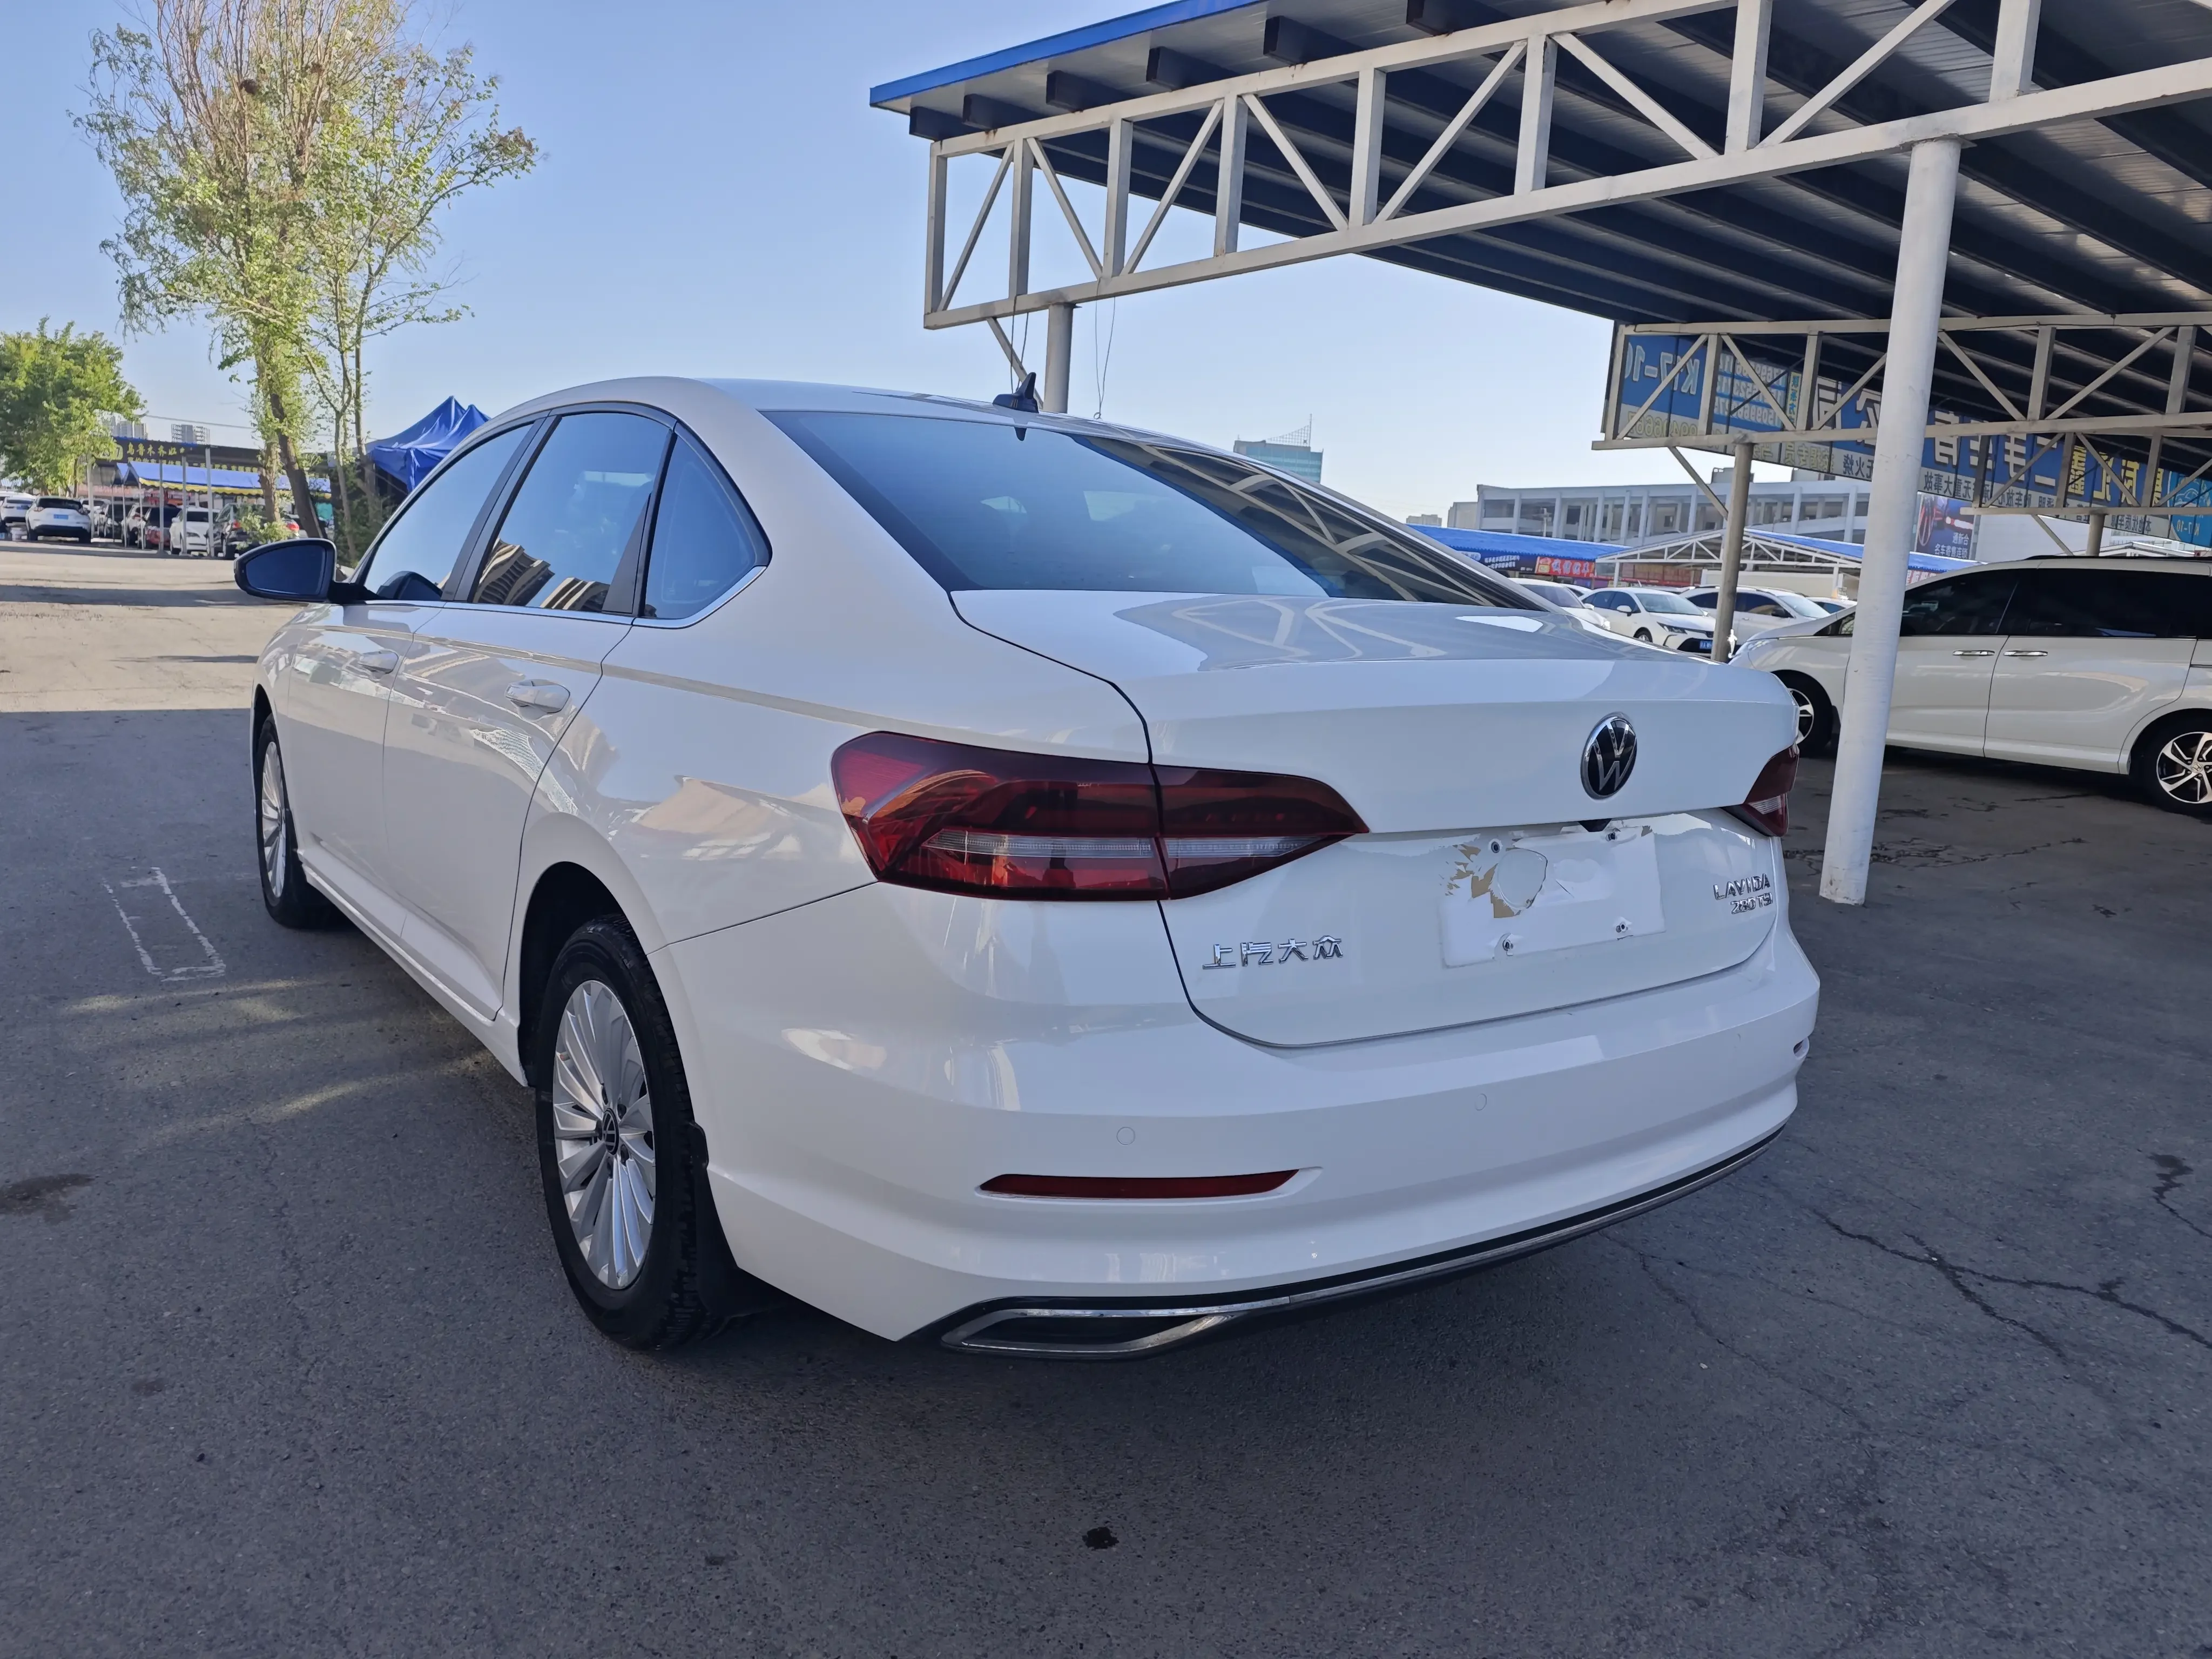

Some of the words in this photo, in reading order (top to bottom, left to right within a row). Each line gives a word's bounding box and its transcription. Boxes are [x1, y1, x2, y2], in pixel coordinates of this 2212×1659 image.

[1713, 873, 1771, 900] LAVIDA
[1202, 935, 1344, 970] 上汽大众
